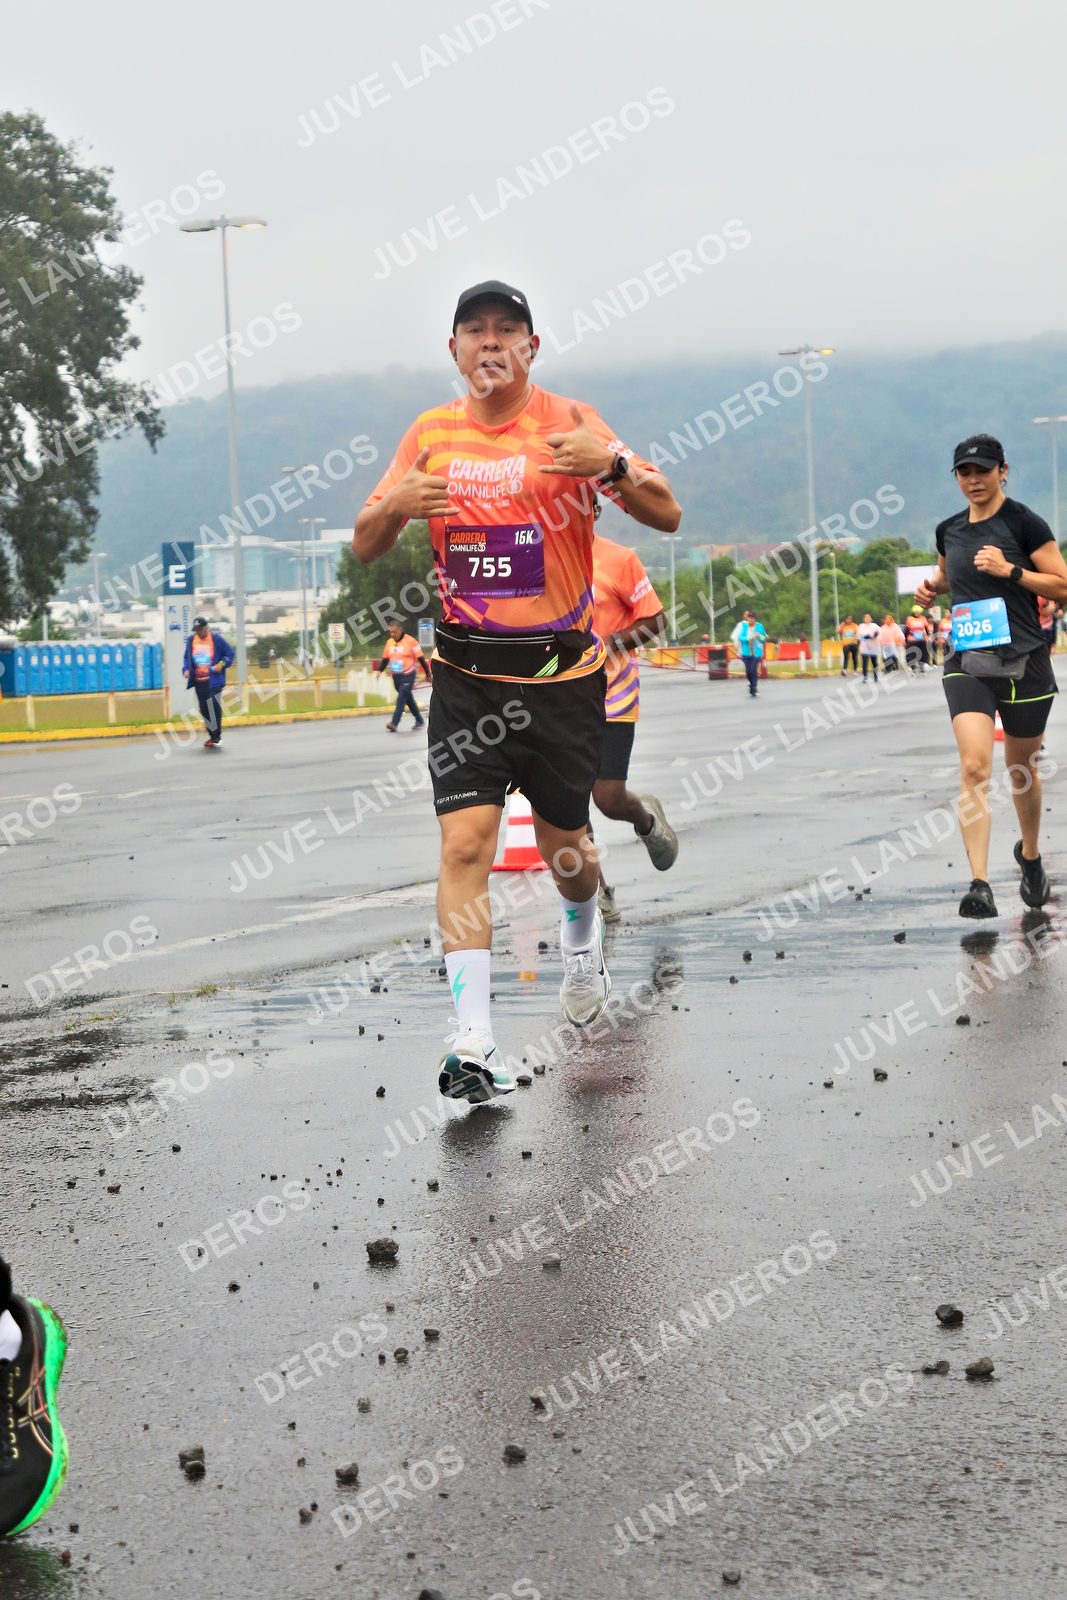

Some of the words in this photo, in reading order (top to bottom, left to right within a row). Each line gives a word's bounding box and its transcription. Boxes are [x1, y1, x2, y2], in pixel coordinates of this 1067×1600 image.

[448, 455, 527, 482] CARRERA
[450, 531, 486, 544] CARRERA
[450, 544, 478, 552] OMNILIFE
[169, 564, 187, 589] E
[468, 557, 512, 578] 755
[957, 618, 992, 637] 2026
